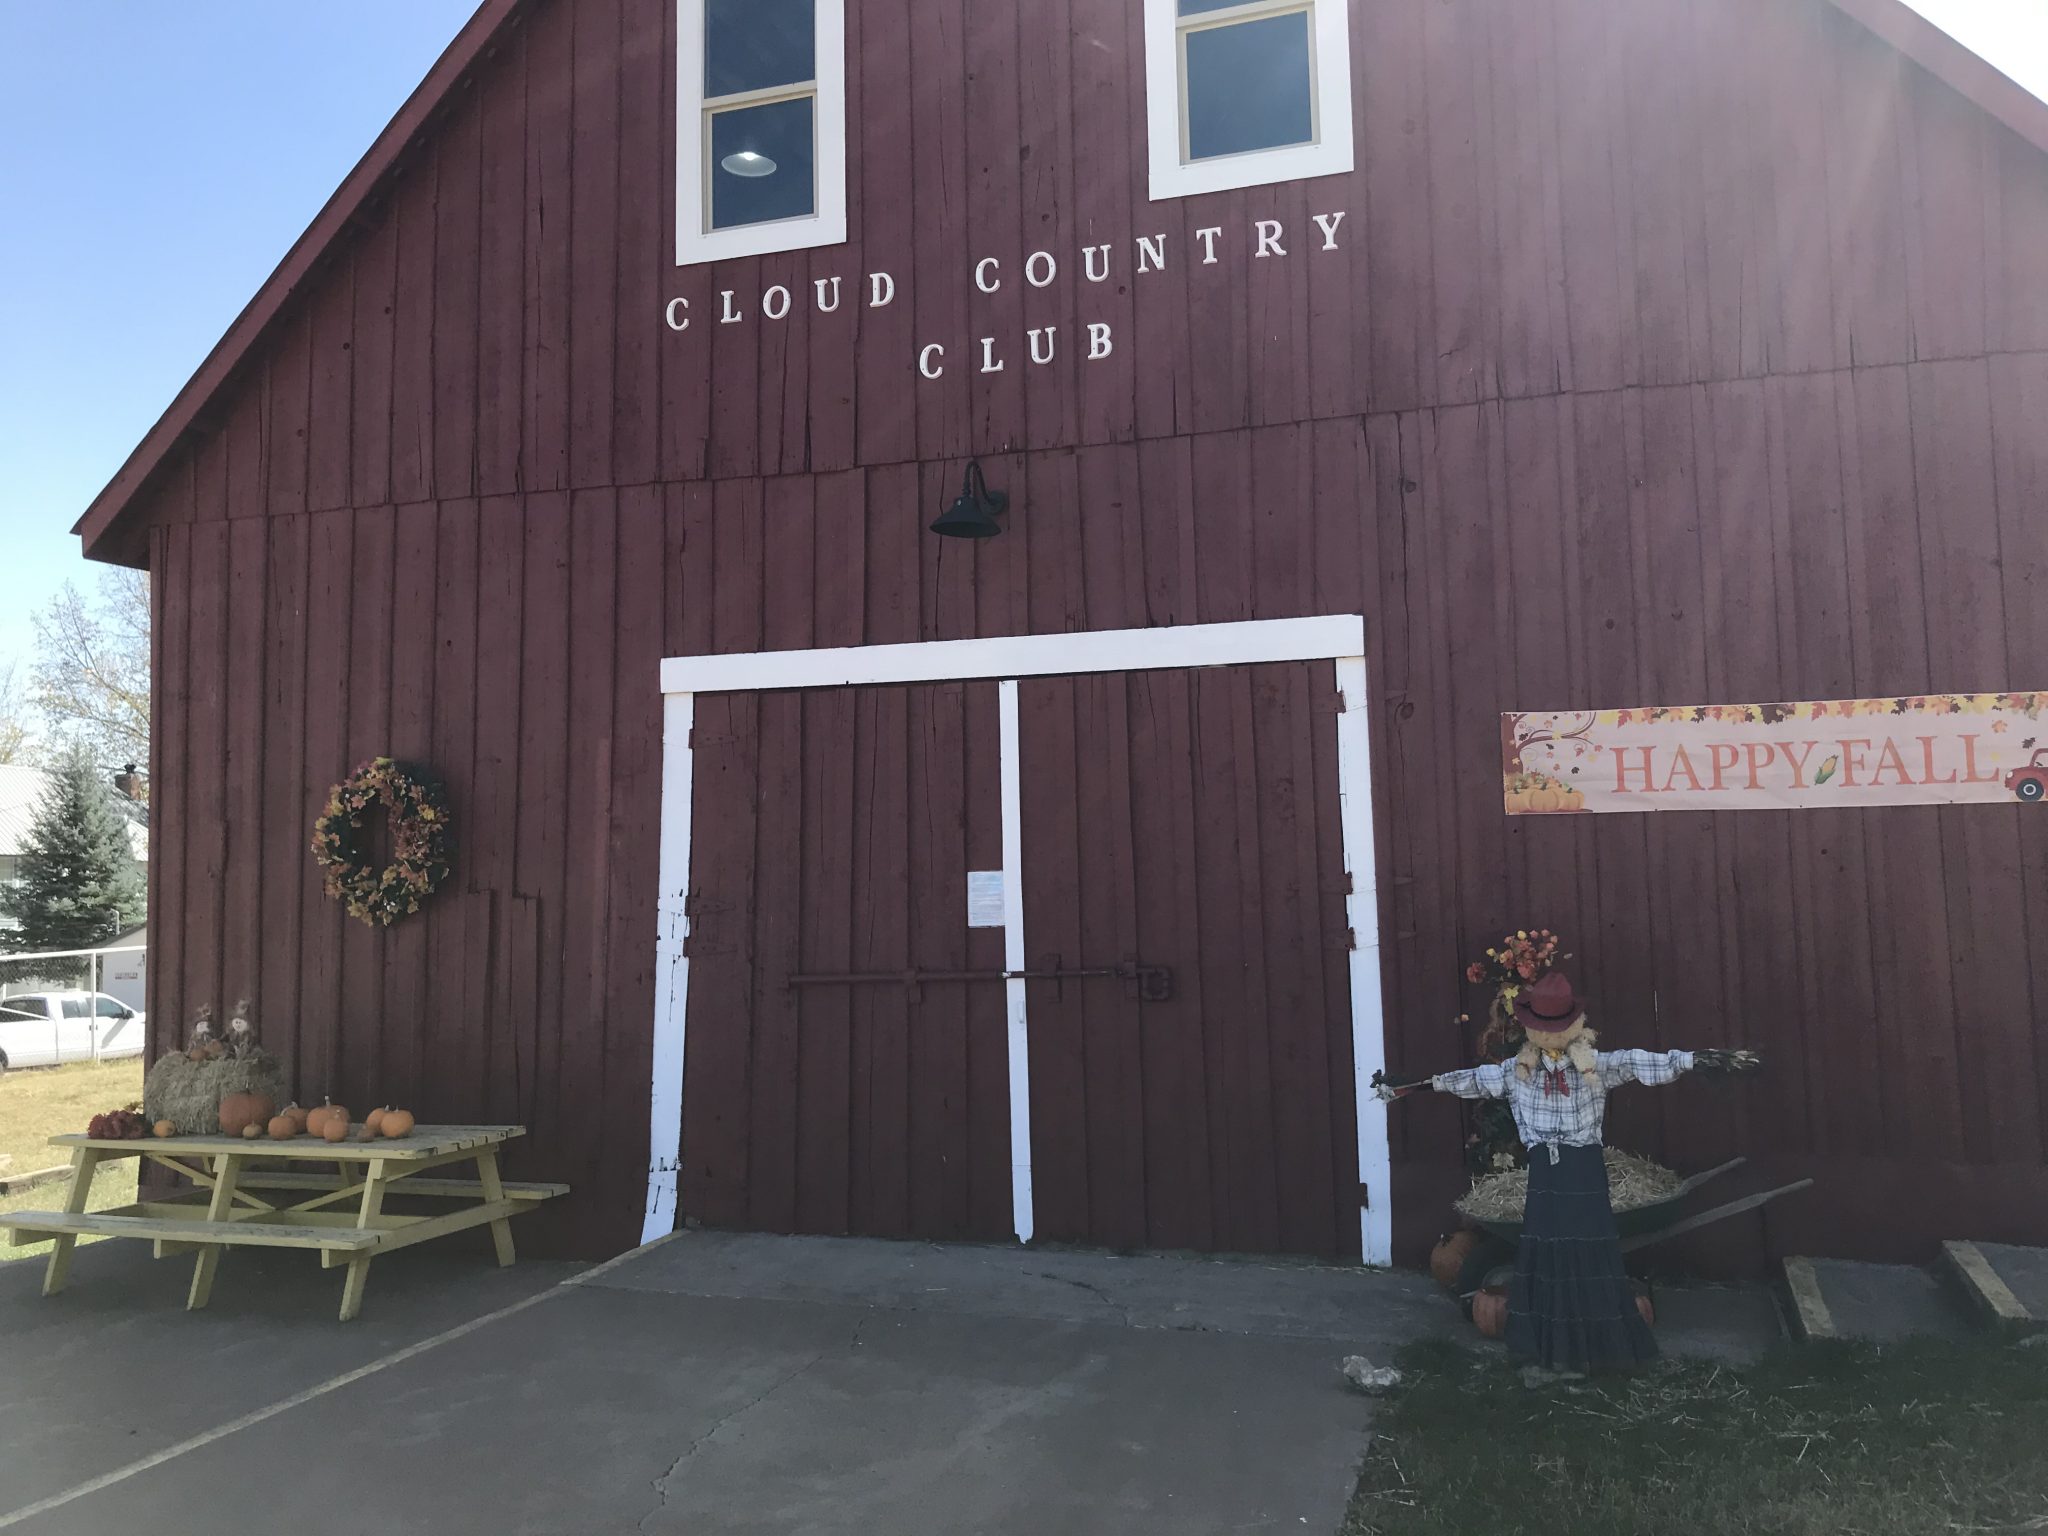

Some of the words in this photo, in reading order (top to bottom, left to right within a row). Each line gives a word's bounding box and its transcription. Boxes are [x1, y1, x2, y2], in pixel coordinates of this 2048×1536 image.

[665, 271, 895, 331] CLOUD
[974, 211, 1346, 293] COUNTRY
[918, 322, 1114, 380] CLUB
[1609, 740, 1819, 793] HAPPY
[1835, 734, 2000, 788] FALL
